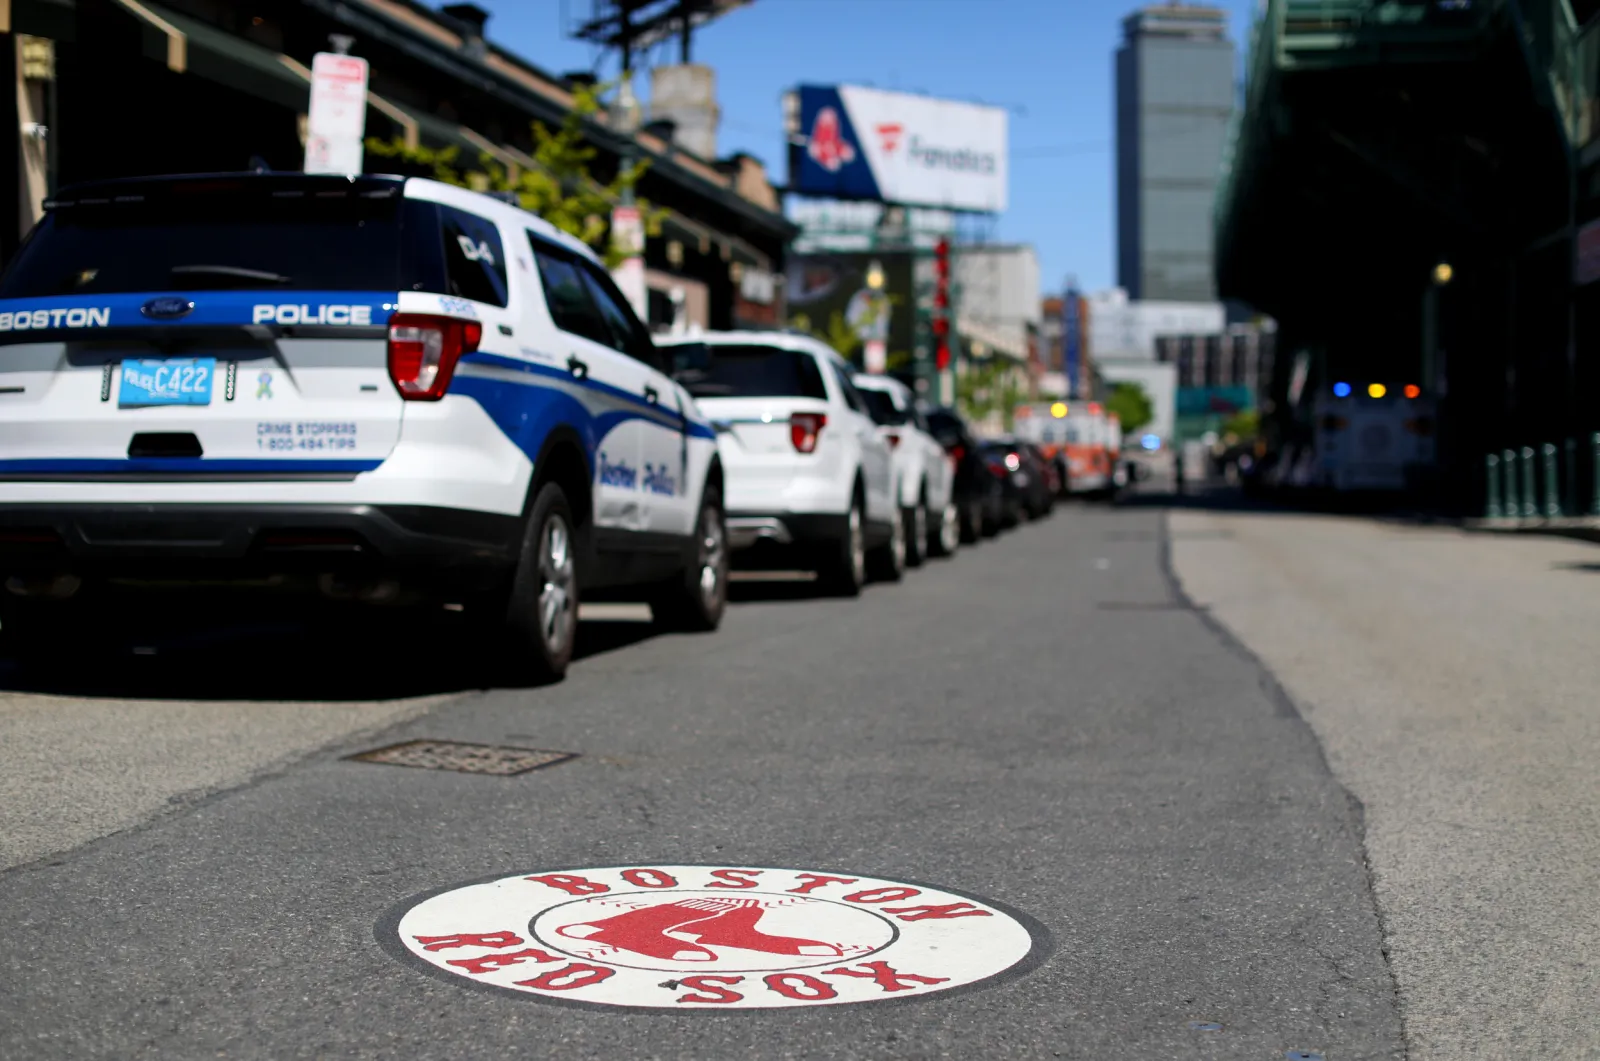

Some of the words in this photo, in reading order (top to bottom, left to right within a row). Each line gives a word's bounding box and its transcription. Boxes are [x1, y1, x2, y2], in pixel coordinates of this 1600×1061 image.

[0, 307, 110, 331] BOSTON
[252, 304, 372, 325] POLICE
[155, 366, 208, 393] C422
[257, 421, 292, 436] CRIME
[297, 421, 356, 436] STOPPERS
[524, 869, 994, 922] BOSTON
[413, 930, 616, 992] RED
[674, 959, 951, 1005] SOX
